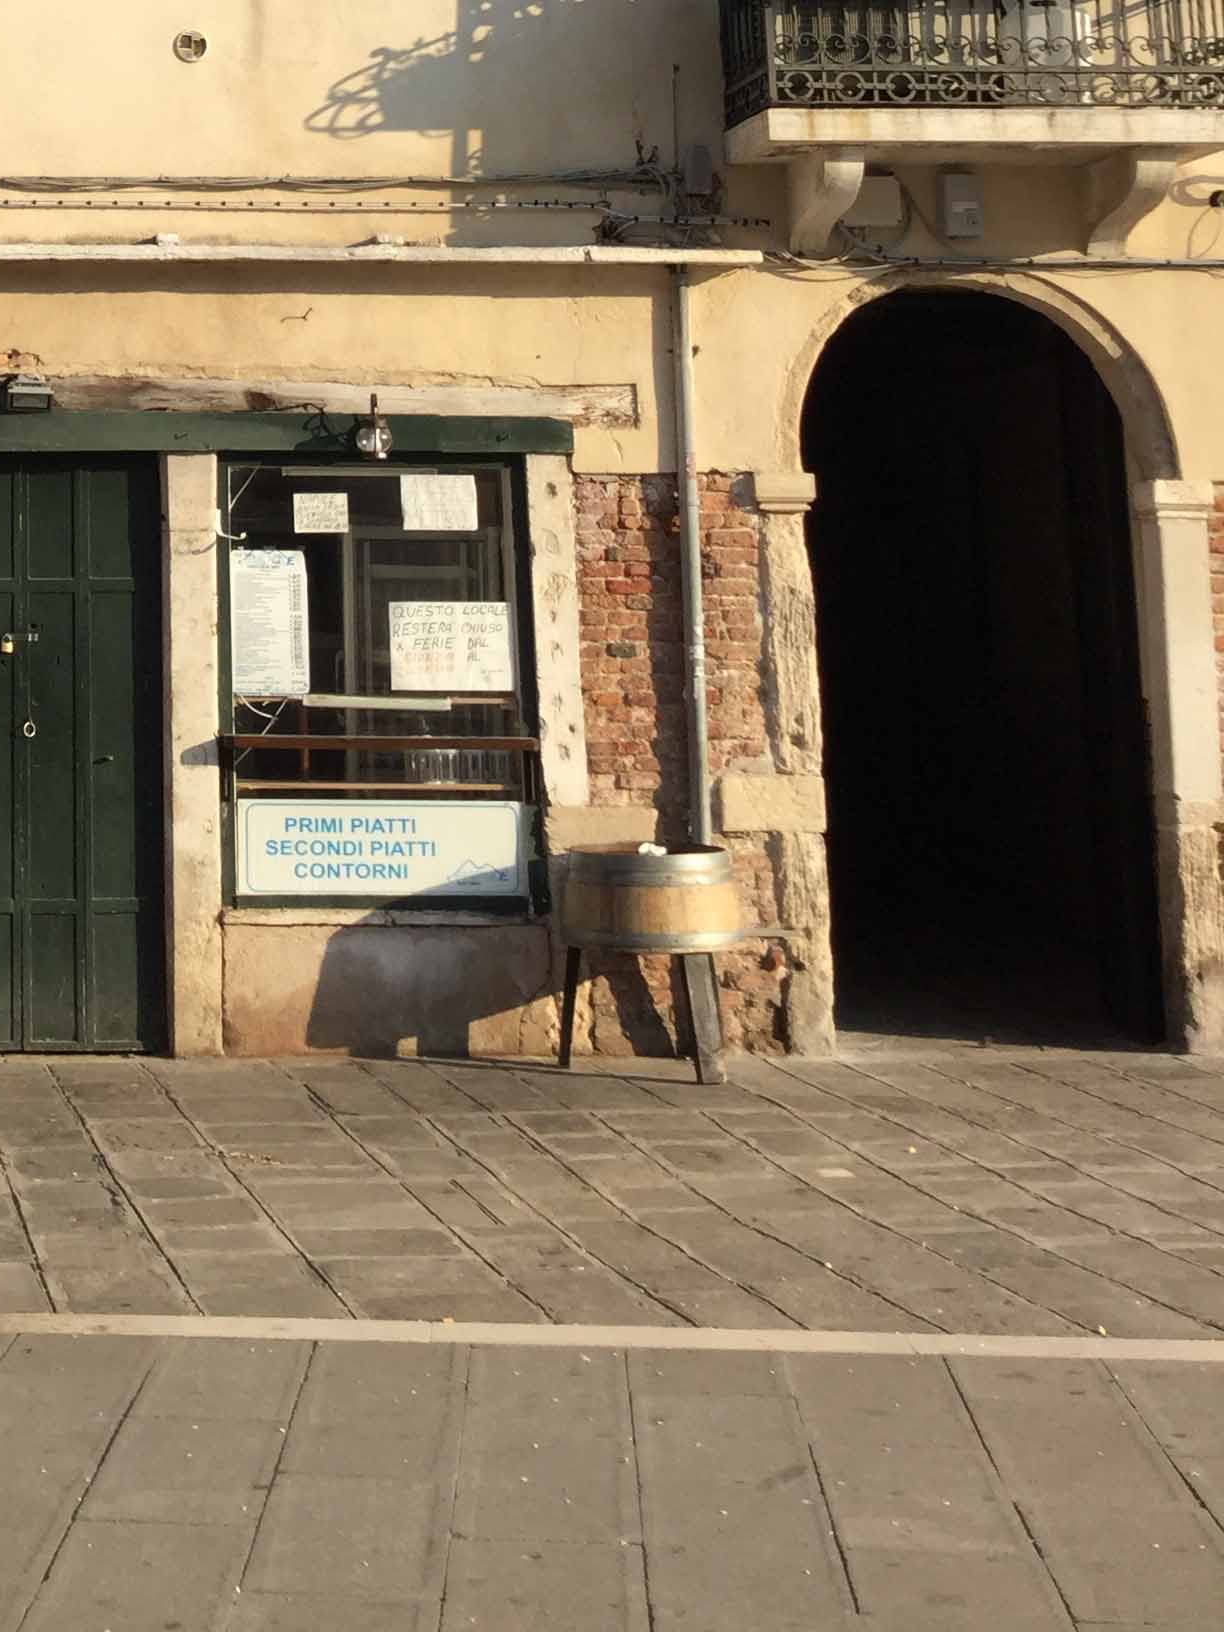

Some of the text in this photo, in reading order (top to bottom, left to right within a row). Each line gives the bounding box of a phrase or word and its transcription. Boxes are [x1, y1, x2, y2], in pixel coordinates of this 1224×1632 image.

[392, 604, 511, 618] QUESTO LOCALE
[412, 636, 456, 651] FERIE
[284, 817, 417, 834] PRIMI PIATTI
[265, 839, 436, 857] SECONDI PIATTI
[294, 862, 409, 880] CONTORNI
